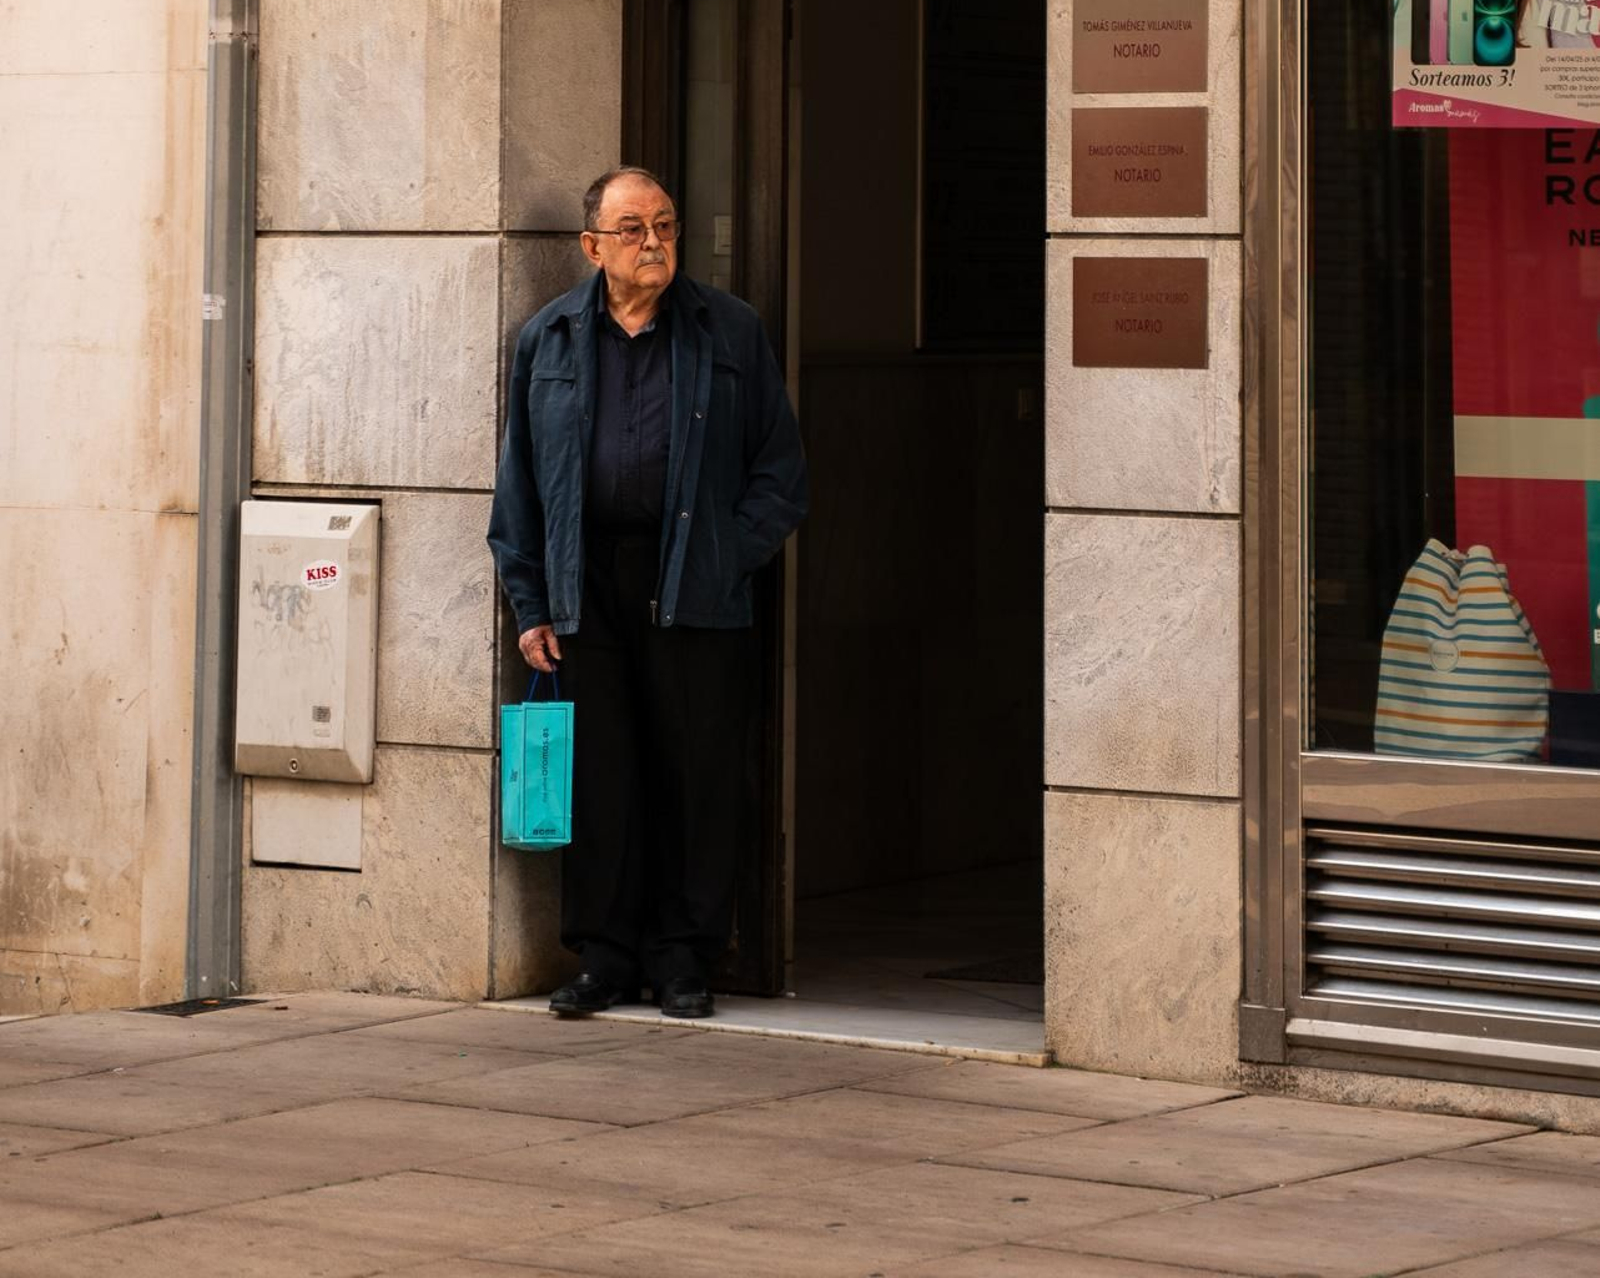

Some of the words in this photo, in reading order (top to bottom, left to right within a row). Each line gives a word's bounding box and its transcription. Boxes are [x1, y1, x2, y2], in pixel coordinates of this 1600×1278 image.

[1113, 44, 1161, 58] NOTARIO
[1409, 68, 1493, 87] Sorteamos
[1497, 68, 1516, 87] 3!
[1114, 169, 1161, 182] NOTARIO
[1115, 319, 1163, 333] NOTARIO
[306, 565, 337, 581] KISS
